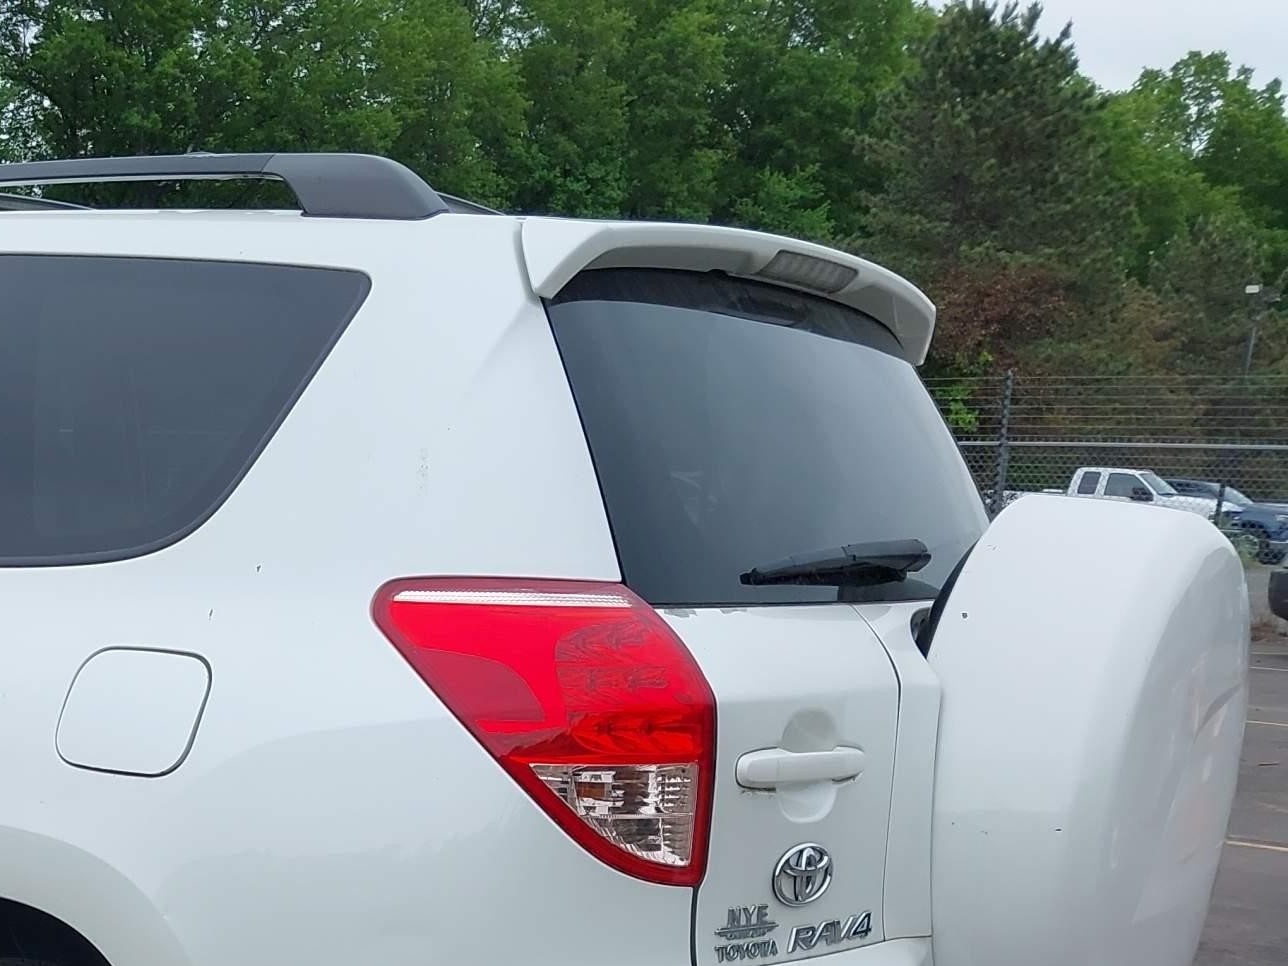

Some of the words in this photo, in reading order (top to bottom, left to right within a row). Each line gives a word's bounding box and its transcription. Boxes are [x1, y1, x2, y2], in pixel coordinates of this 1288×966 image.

[726, 904, 769, 929] NYE
[787, 910, 873, 953] RAV4
[713, 940, 779, 963] TOYOTA
